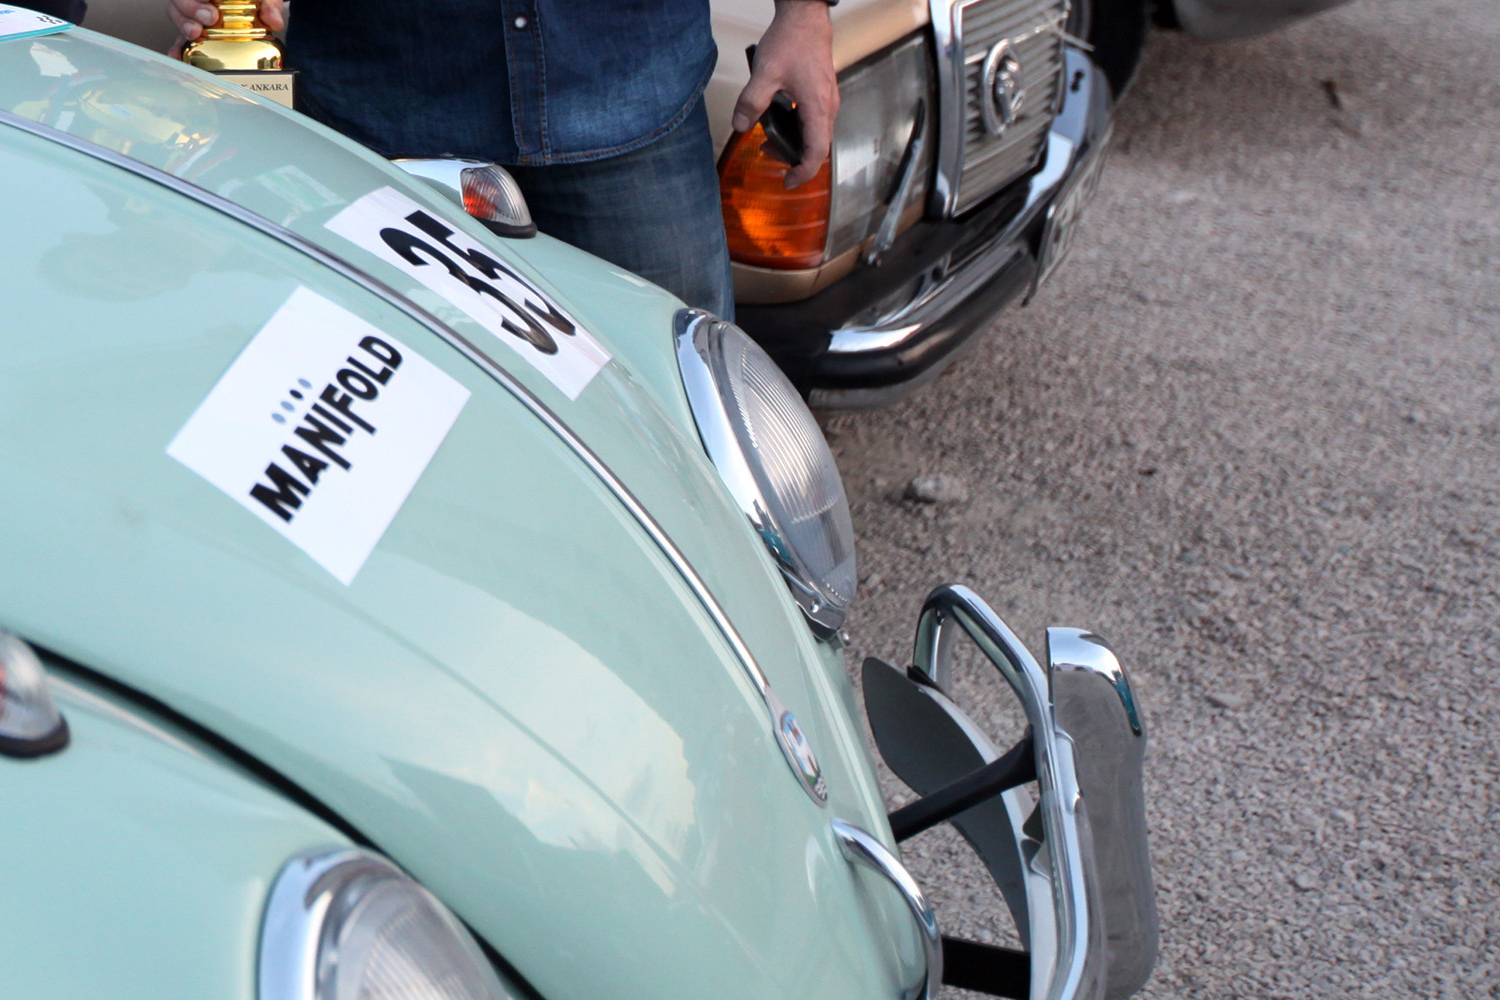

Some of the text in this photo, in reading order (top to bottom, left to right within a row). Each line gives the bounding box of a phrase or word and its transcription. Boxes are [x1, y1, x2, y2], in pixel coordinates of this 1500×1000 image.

[249, 83, 289, 91] ANKARA
[379, 210, 576, 356] 35
[249, 335, 404, 524] MANIFOLD
